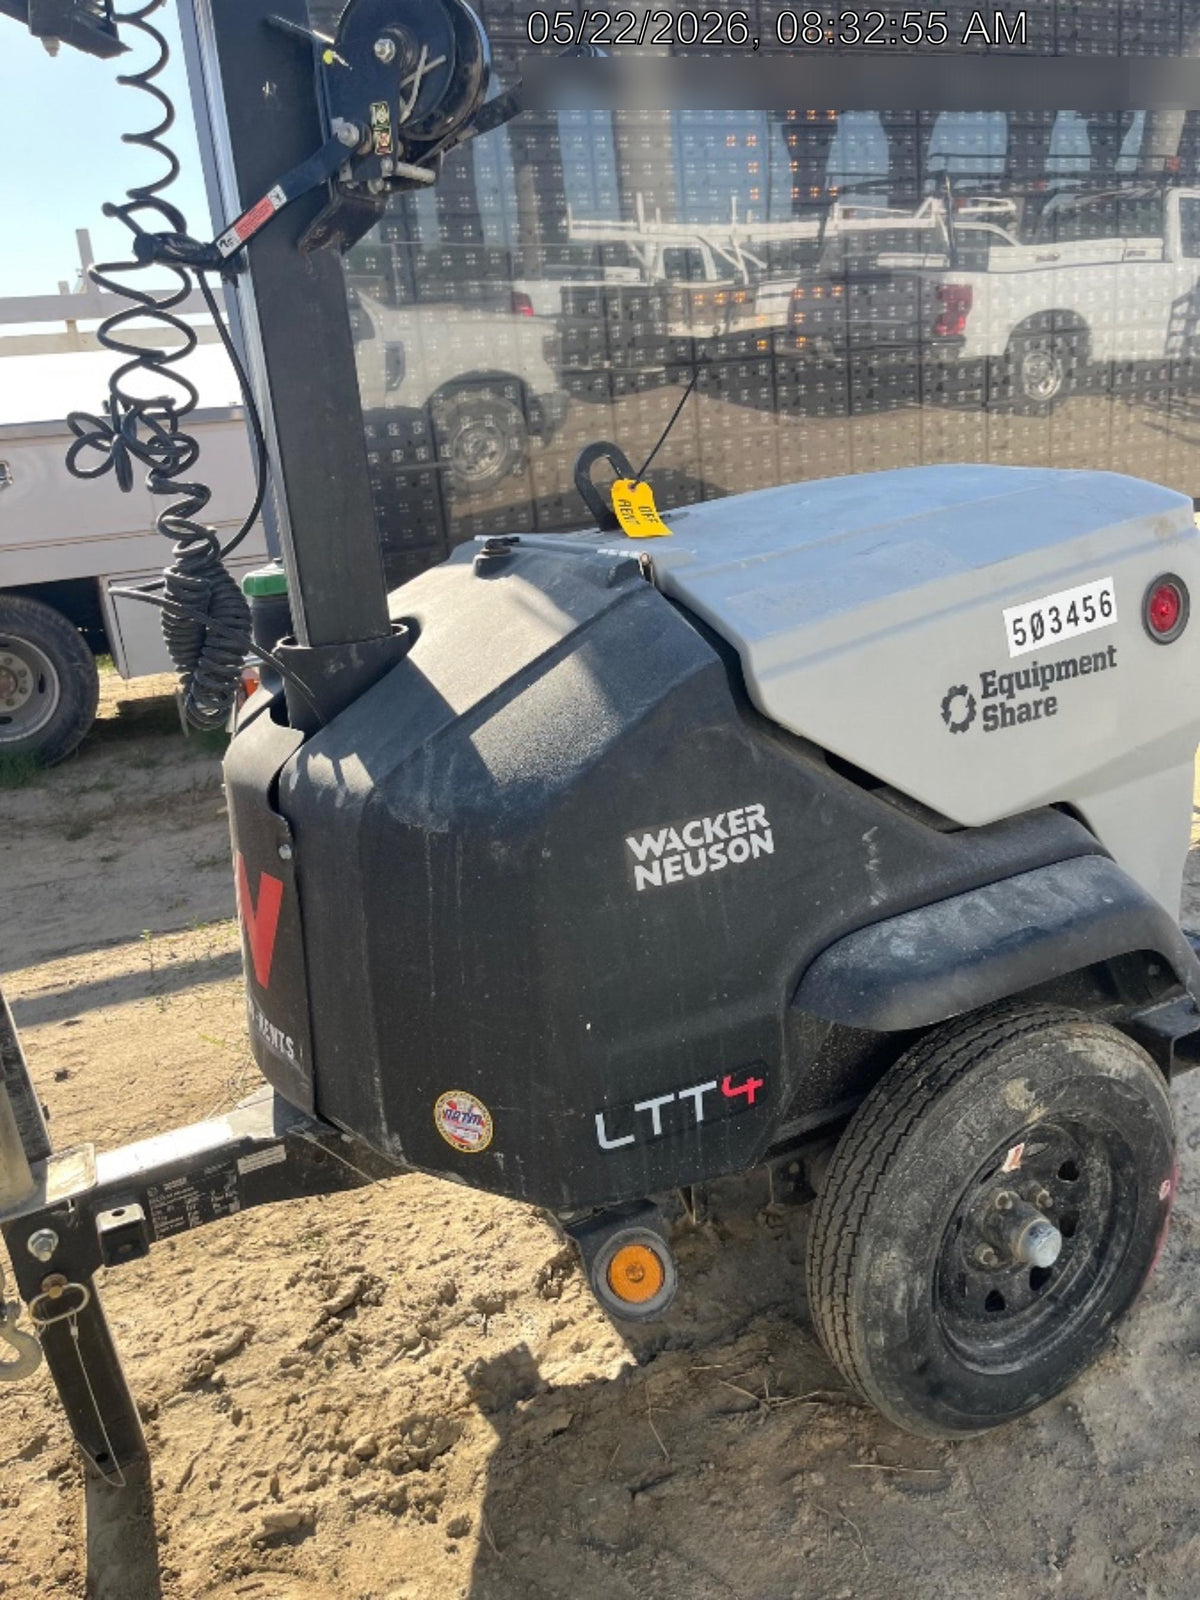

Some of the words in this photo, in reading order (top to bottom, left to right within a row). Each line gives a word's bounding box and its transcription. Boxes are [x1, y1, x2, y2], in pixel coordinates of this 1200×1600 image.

[638, 506, 659, 523] OFF
[1012, 589, 1113, 647] 503456
[979, 644, 1118, 701] Equipment
[982, 695, 1059, 733] Share
[625, 802, 771, 862] WACKER
[633, 827, 775, 892] NEUSON
[594, 1075, 764, 1150] LTT4
